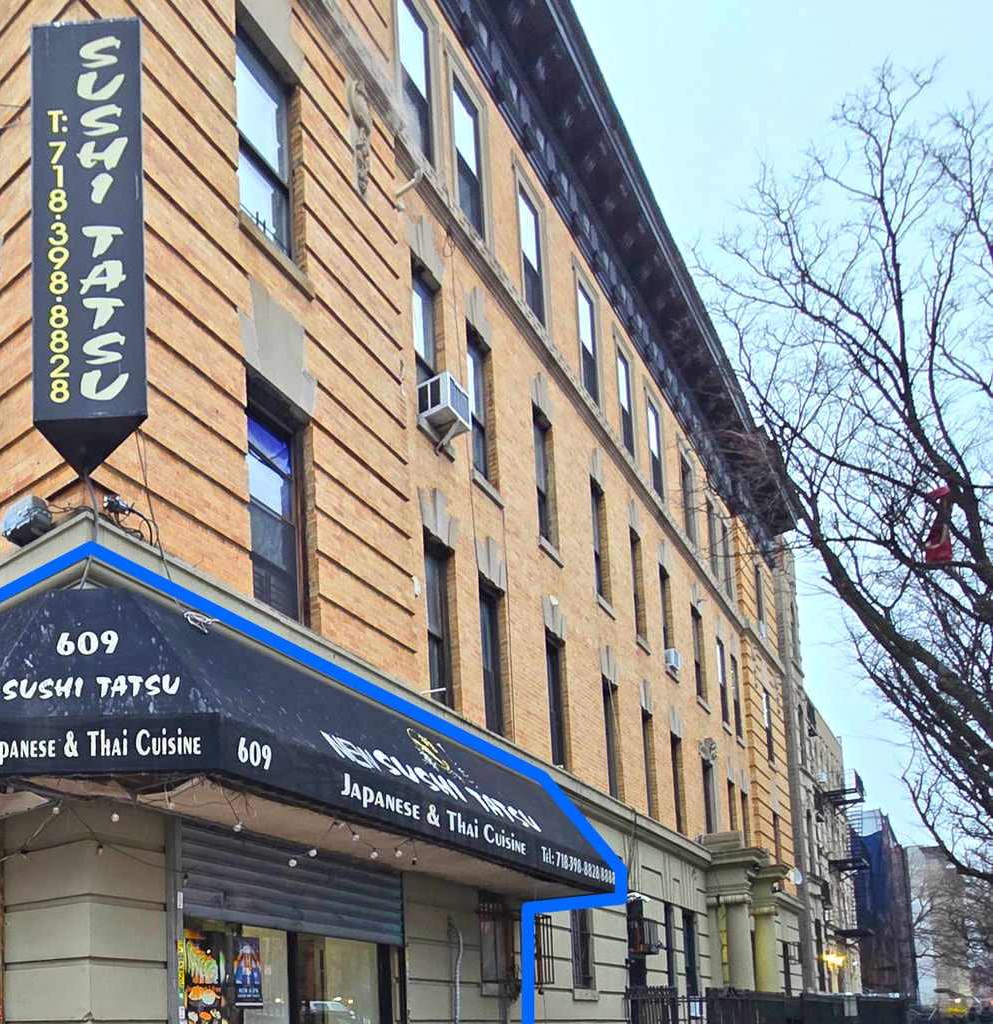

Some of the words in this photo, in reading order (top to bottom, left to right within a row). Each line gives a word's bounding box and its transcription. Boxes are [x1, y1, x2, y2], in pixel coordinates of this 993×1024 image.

[76, 35, 128, 204] SUSHI
[79, 225, 130, 400] TATSU
[56, 630, 119, 656] 609
[2, 677, 84, 701] SUSHI
[96, 674, 181, 698] TATSU
[64, 731, 79, 757] &
[87, 729, 128, 757] Thai
[136, 728, 202, 756] Cuisine
[237, 737, 272, 770] 609
[341, 773, 420, 820] Japanese
[427, 804, 440, 826] &
[446, 810, 479, 839] Thai
[483, 824, 527, 856] Cuisine
[373, 749, 467, 803] SUSHI
[464, 787, 542, 832] TATSU
